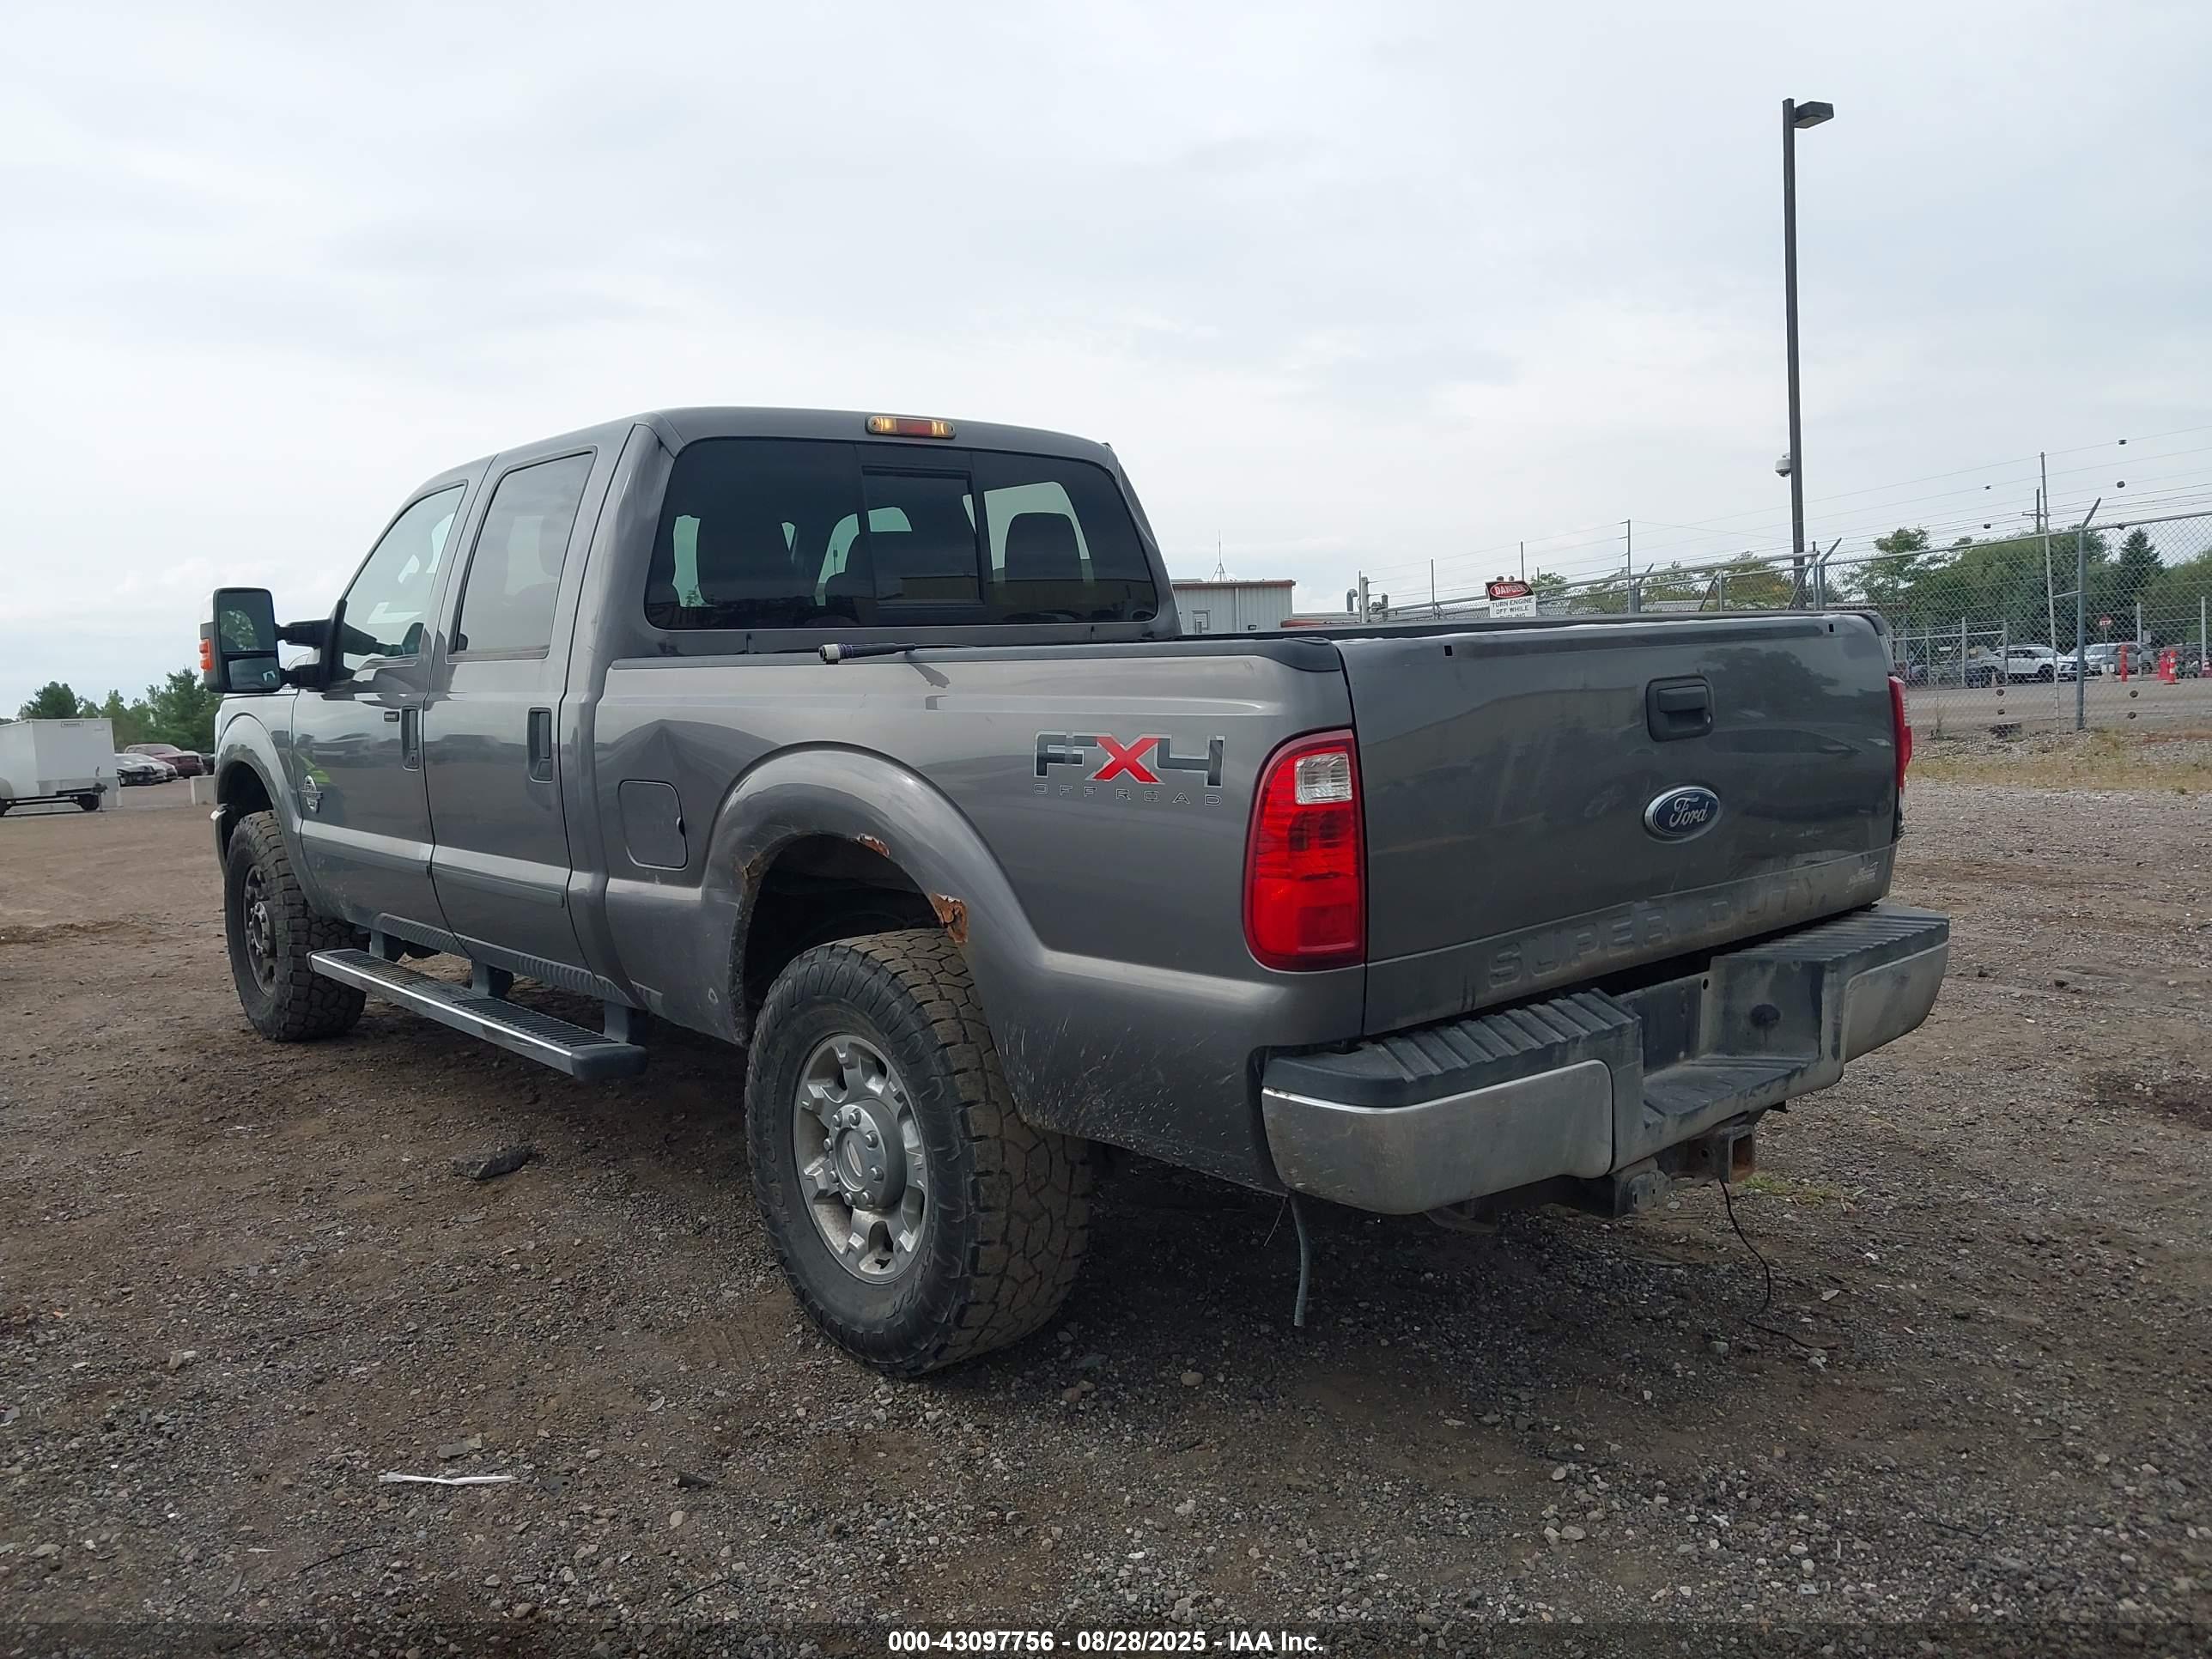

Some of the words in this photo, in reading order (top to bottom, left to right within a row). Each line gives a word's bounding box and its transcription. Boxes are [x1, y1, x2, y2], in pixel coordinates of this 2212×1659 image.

[1494, 585, 1526, 595] DANGER
[1510, 597, 1533, 605] ENGINE
[1034, 730, 1226, 788] FX4
[1668, 796, 1710, 828] Ford
[1488, 903, 1673, 989] SUPER
[1701, 876, 1817, 933] DUTY
